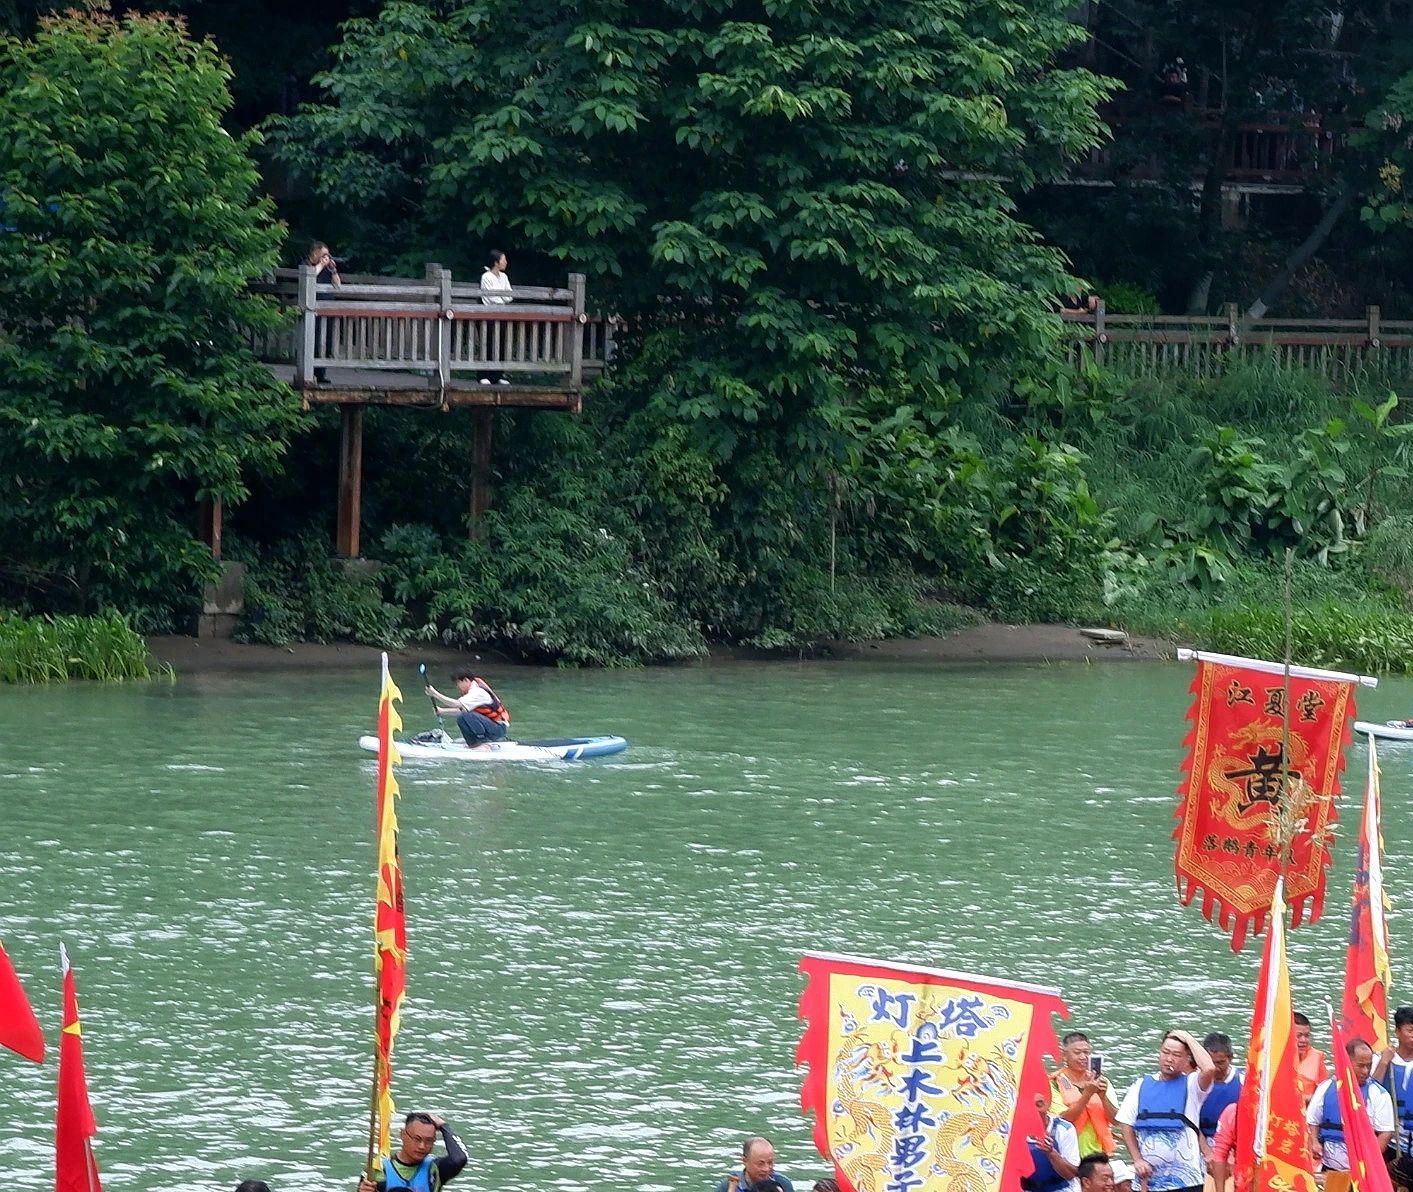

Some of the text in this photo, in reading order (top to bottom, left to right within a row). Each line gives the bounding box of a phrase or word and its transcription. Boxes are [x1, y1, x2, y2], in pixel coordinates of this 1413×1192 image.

[1226, 681, 1324, 723] 江夏堂
[1224, 743, 1301, 816] 黄
[870, 986, 989, 1038] 灯塔
